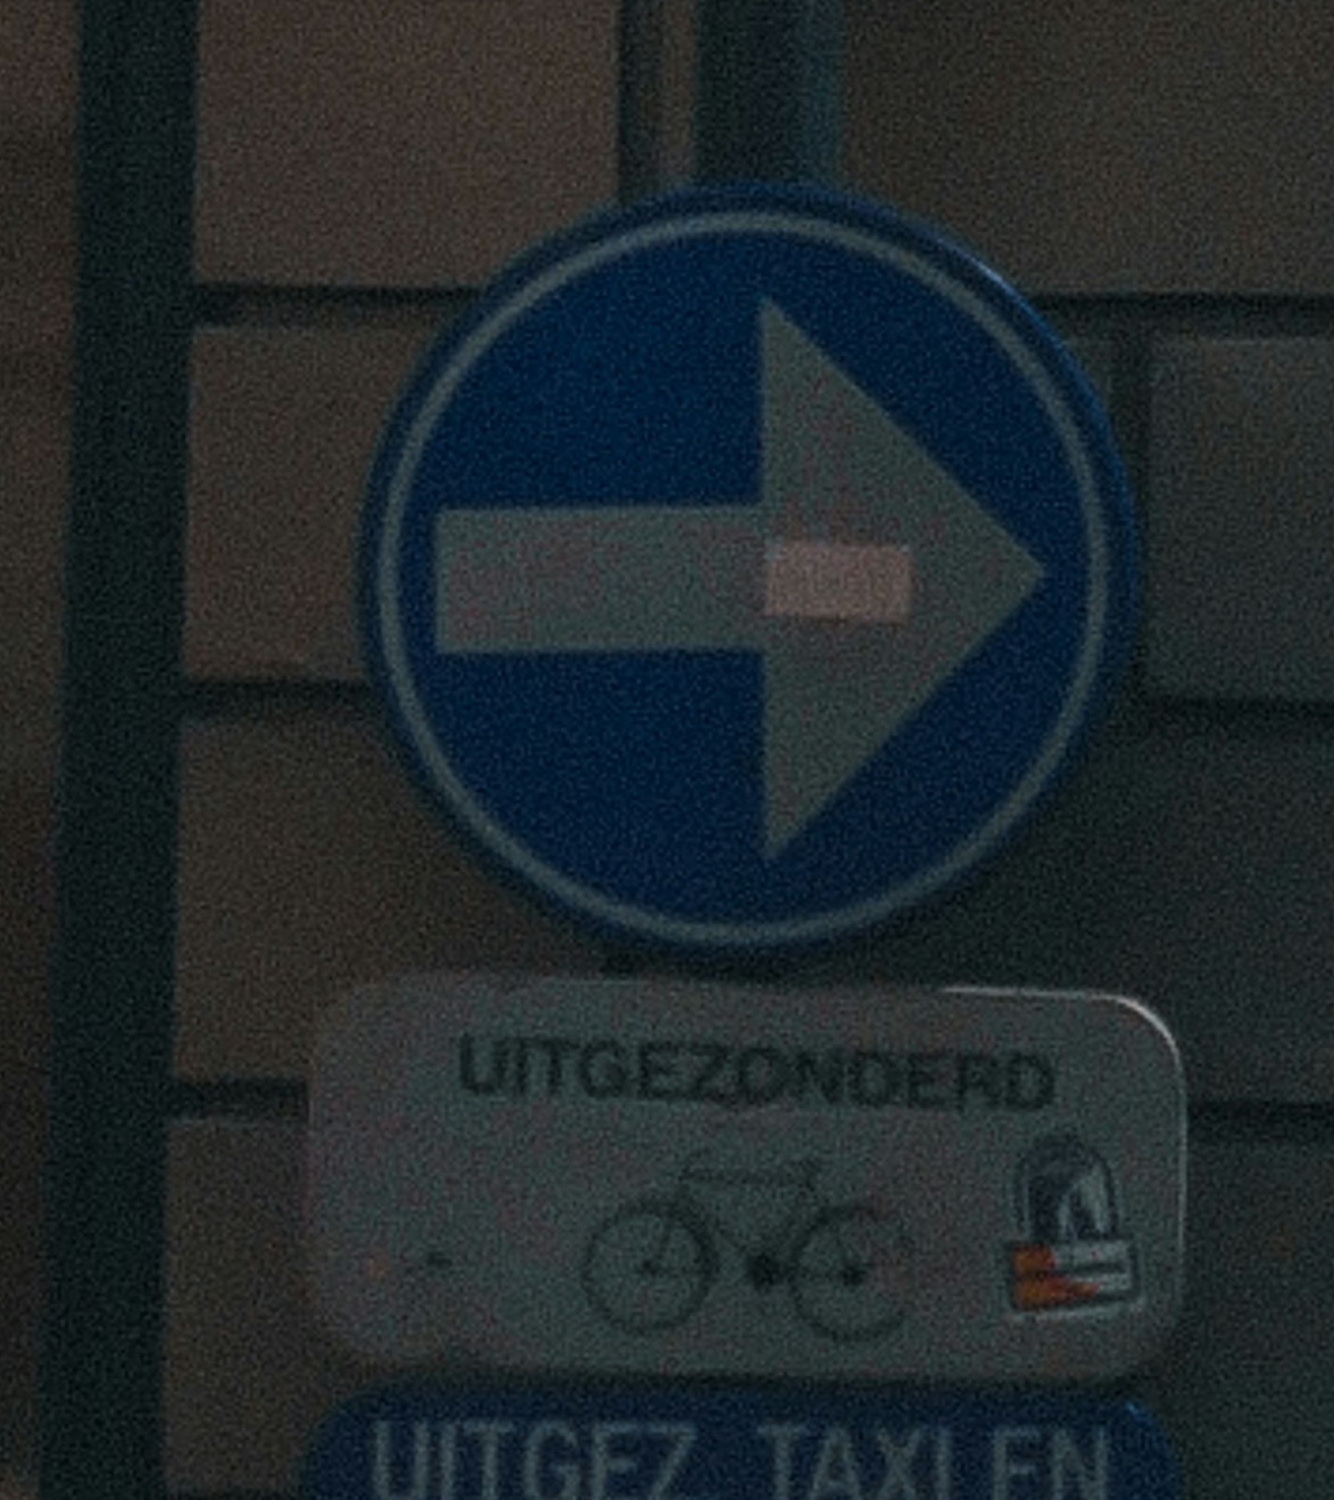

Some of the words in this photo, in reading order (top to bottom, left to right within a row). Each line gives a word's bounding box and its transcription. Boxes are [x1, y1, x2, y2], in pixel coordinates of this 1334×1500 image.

[458, 1036, 1056, 1111] UITGEZONDERD
[756, 1424, 953, 1500] TAXI
[989, 1425, 1111, 1500] EN
